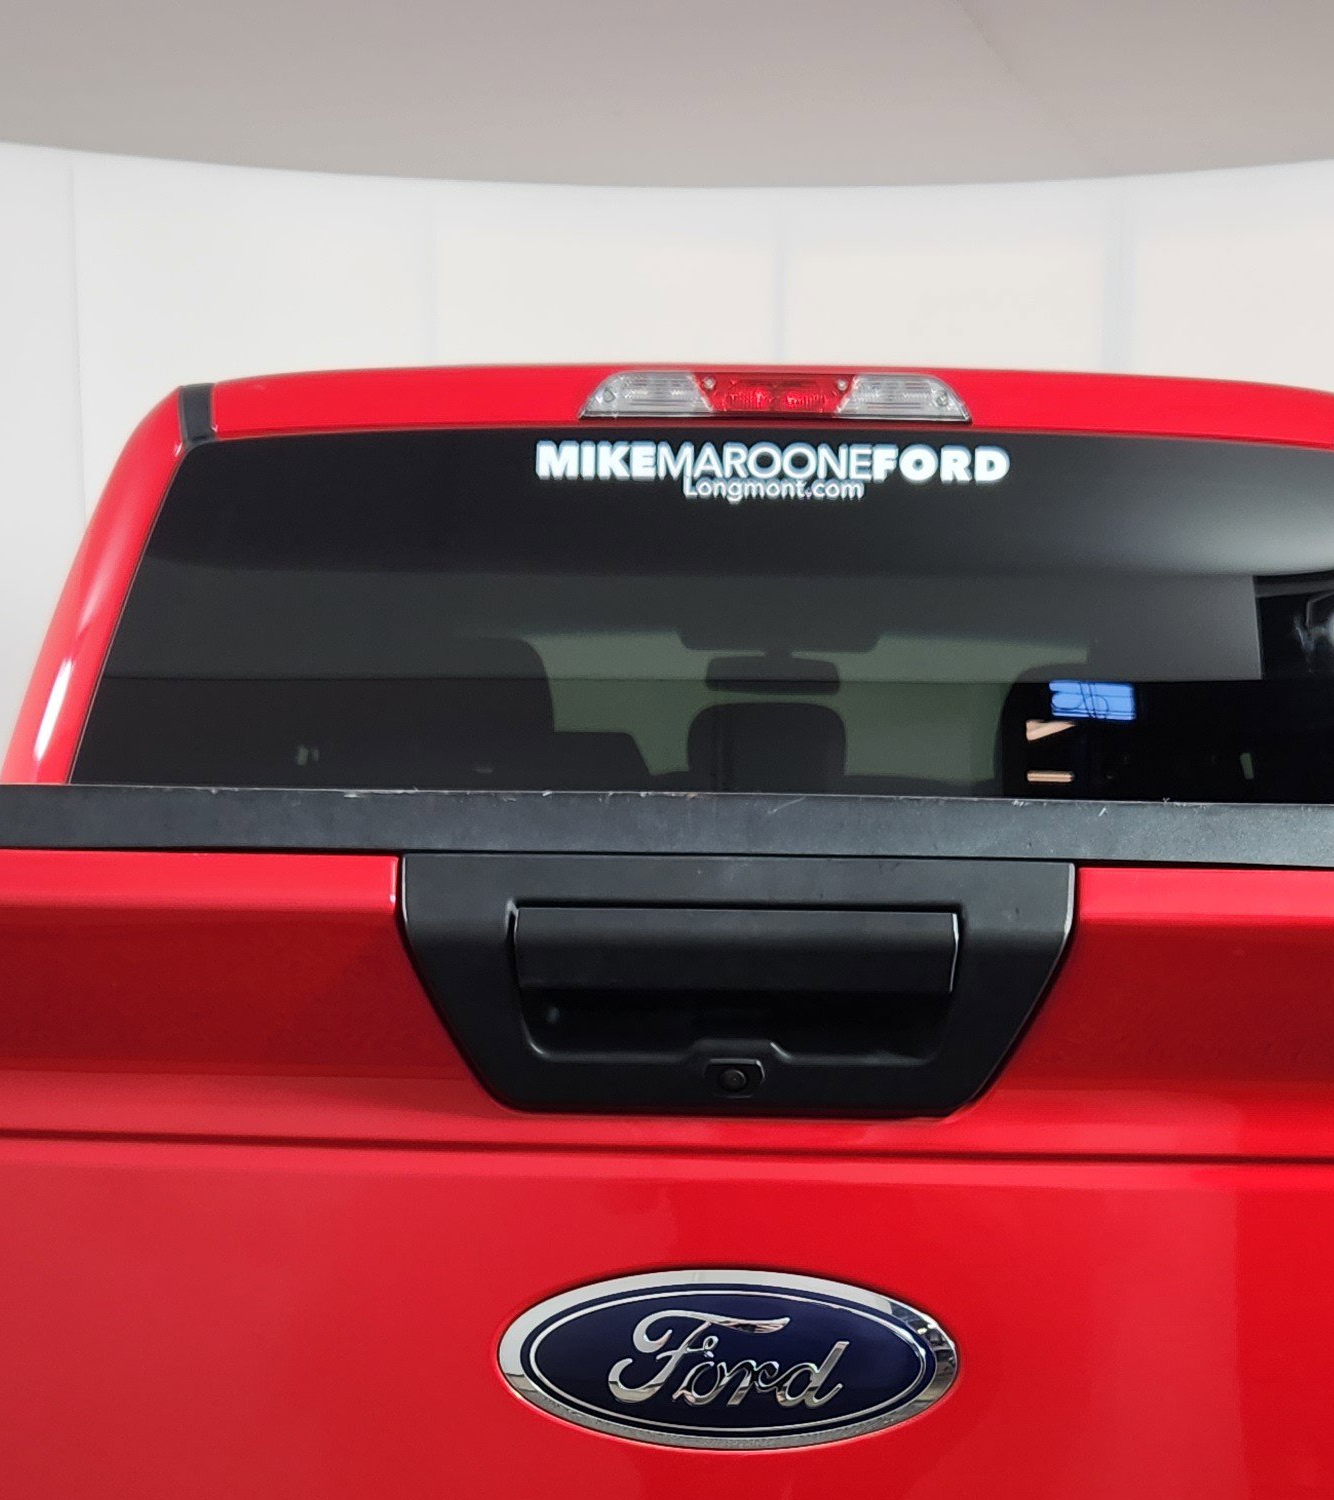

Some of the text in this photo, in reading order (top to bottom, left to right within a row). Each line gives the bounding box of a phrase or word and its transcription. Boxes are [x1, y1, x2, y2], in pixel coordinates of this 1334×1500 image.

[535, 440, 1010, 484] MIKEMAROONEFORD
[683, 475, 865, 504] Longmont.com
[608, 1309, 850, 1407] Ford
